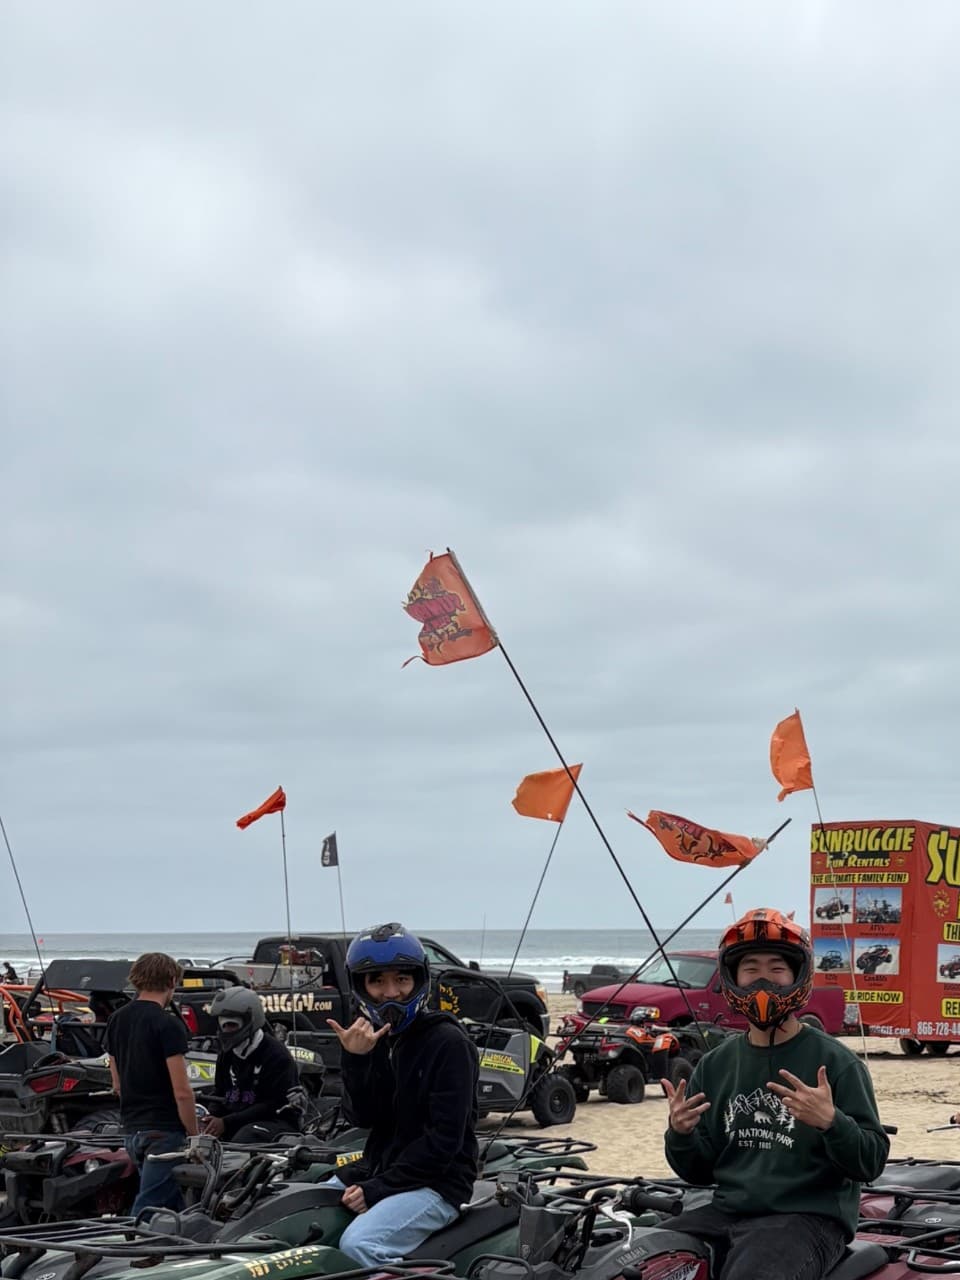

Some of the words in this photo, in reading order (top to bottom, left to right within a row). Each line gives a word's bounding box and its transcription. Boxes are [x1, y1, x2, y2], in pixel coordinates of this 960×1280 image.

[811, 827, 915, 853] SUNBUGGIE
[857, 991, 875, 1001] RIDE
[876, 992, 900, 1002] NOW
